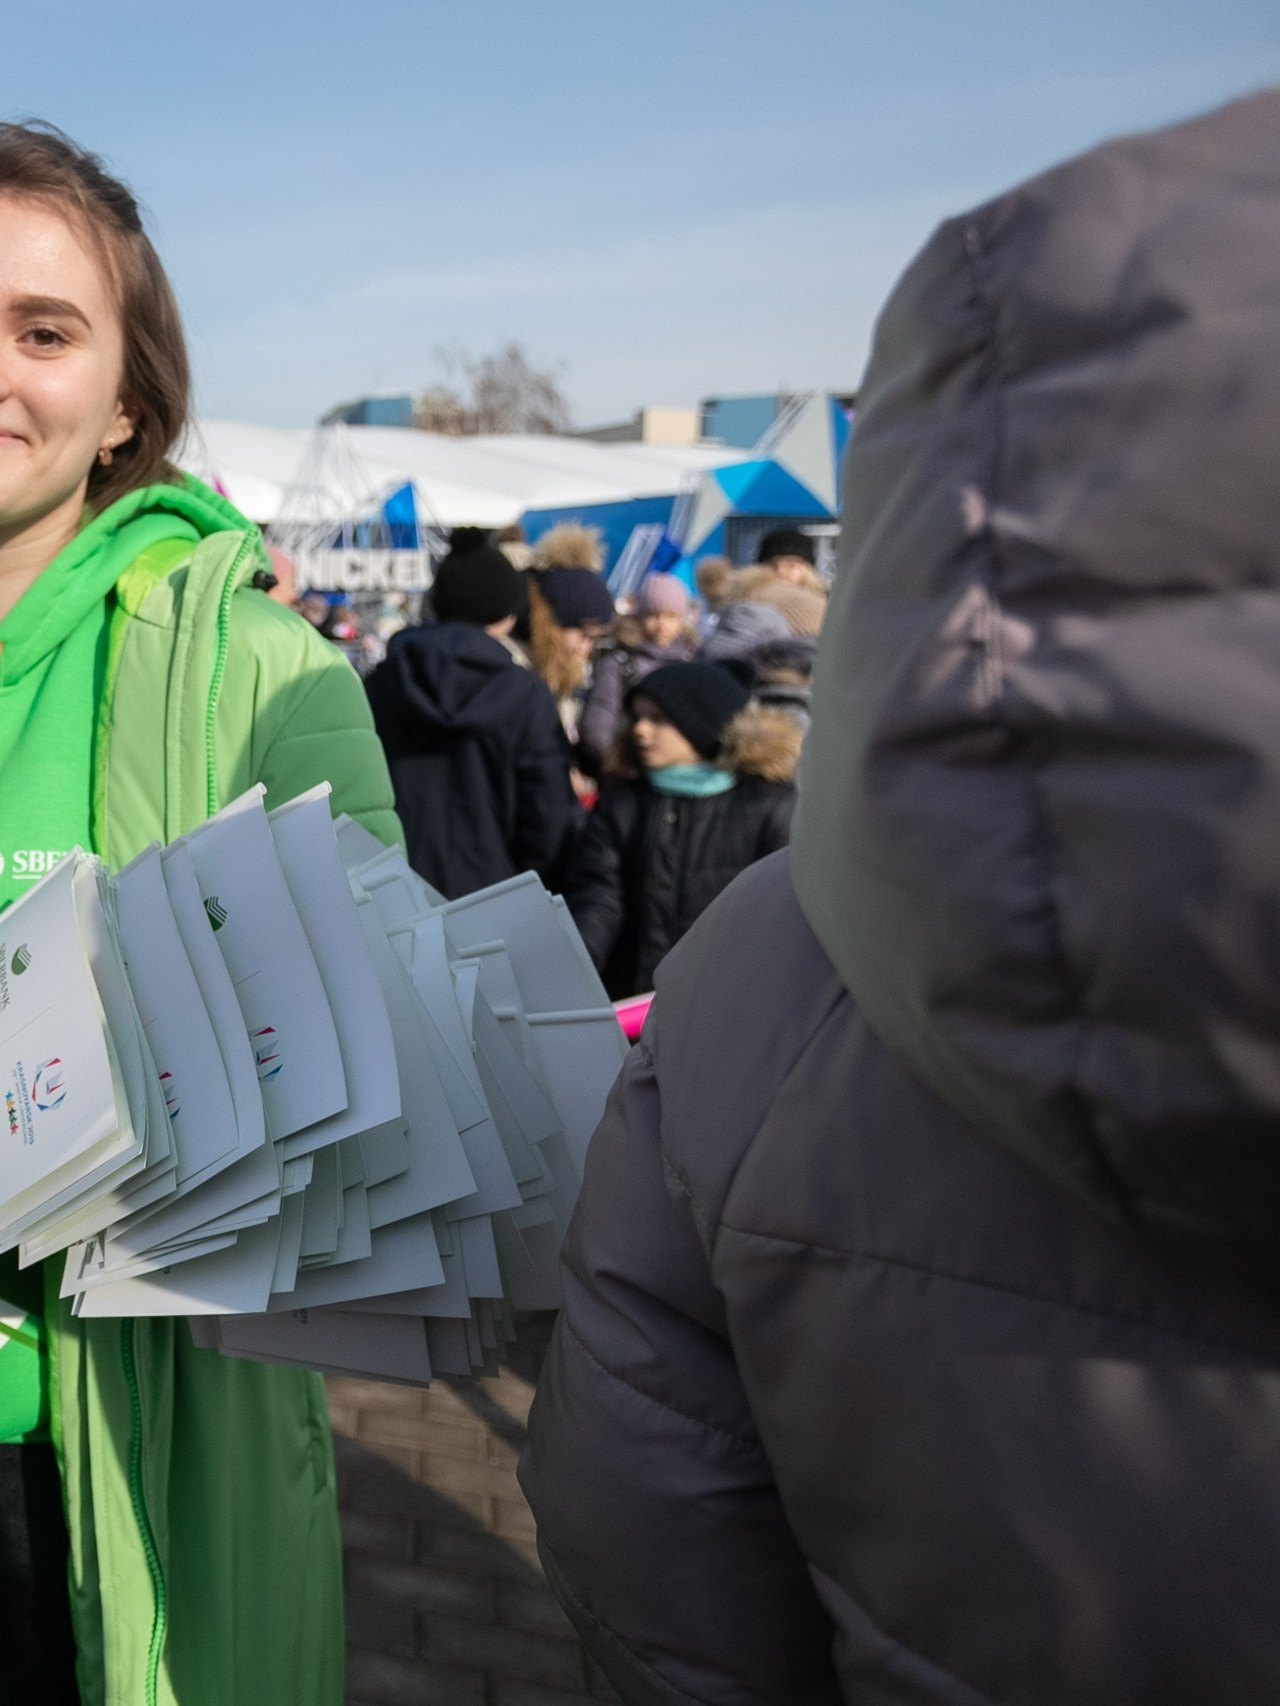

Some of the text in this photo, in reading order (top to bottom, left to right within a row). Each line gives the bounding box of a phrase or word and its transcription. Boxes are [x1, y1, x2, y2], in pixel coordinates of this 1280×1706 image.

[294, 549, 434, 592] NICKEL
[11, 850, 69, 873] SBE
[0, 942, 10, 1010] SBERBANK
